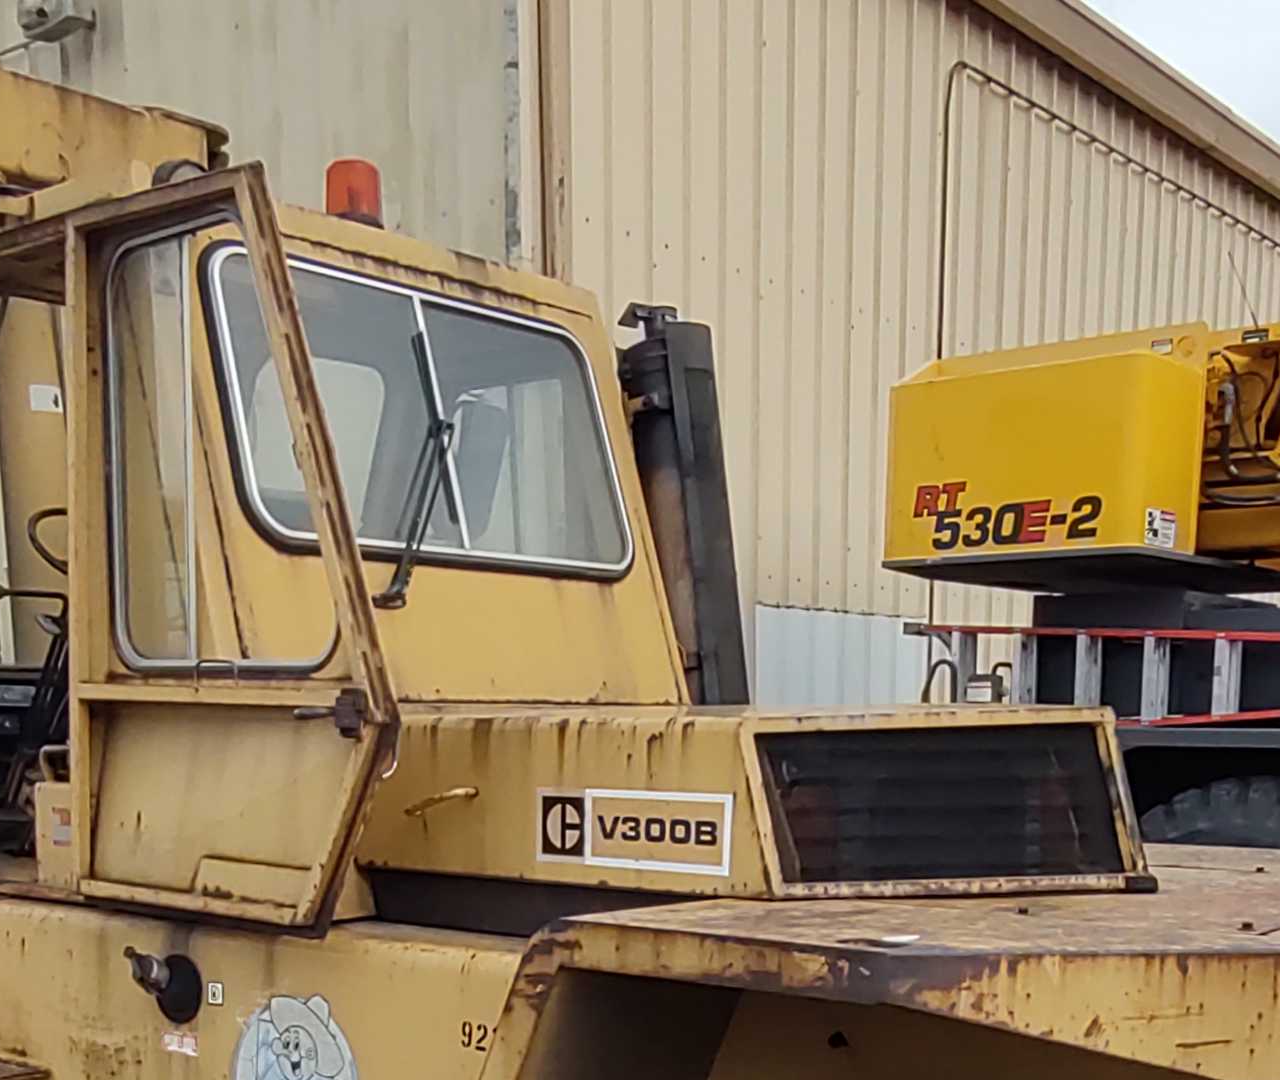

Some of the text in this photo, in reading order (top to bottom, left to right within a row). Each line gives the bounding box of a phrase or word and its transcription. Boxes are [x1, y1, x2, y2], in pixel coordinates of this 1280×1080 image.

[913, 481, 967, 518] RT
[931, 495, 1103, 550] 530E-2
[597, 814, 718, 847] V300B
[461, 1021, 498, 1052] 92
